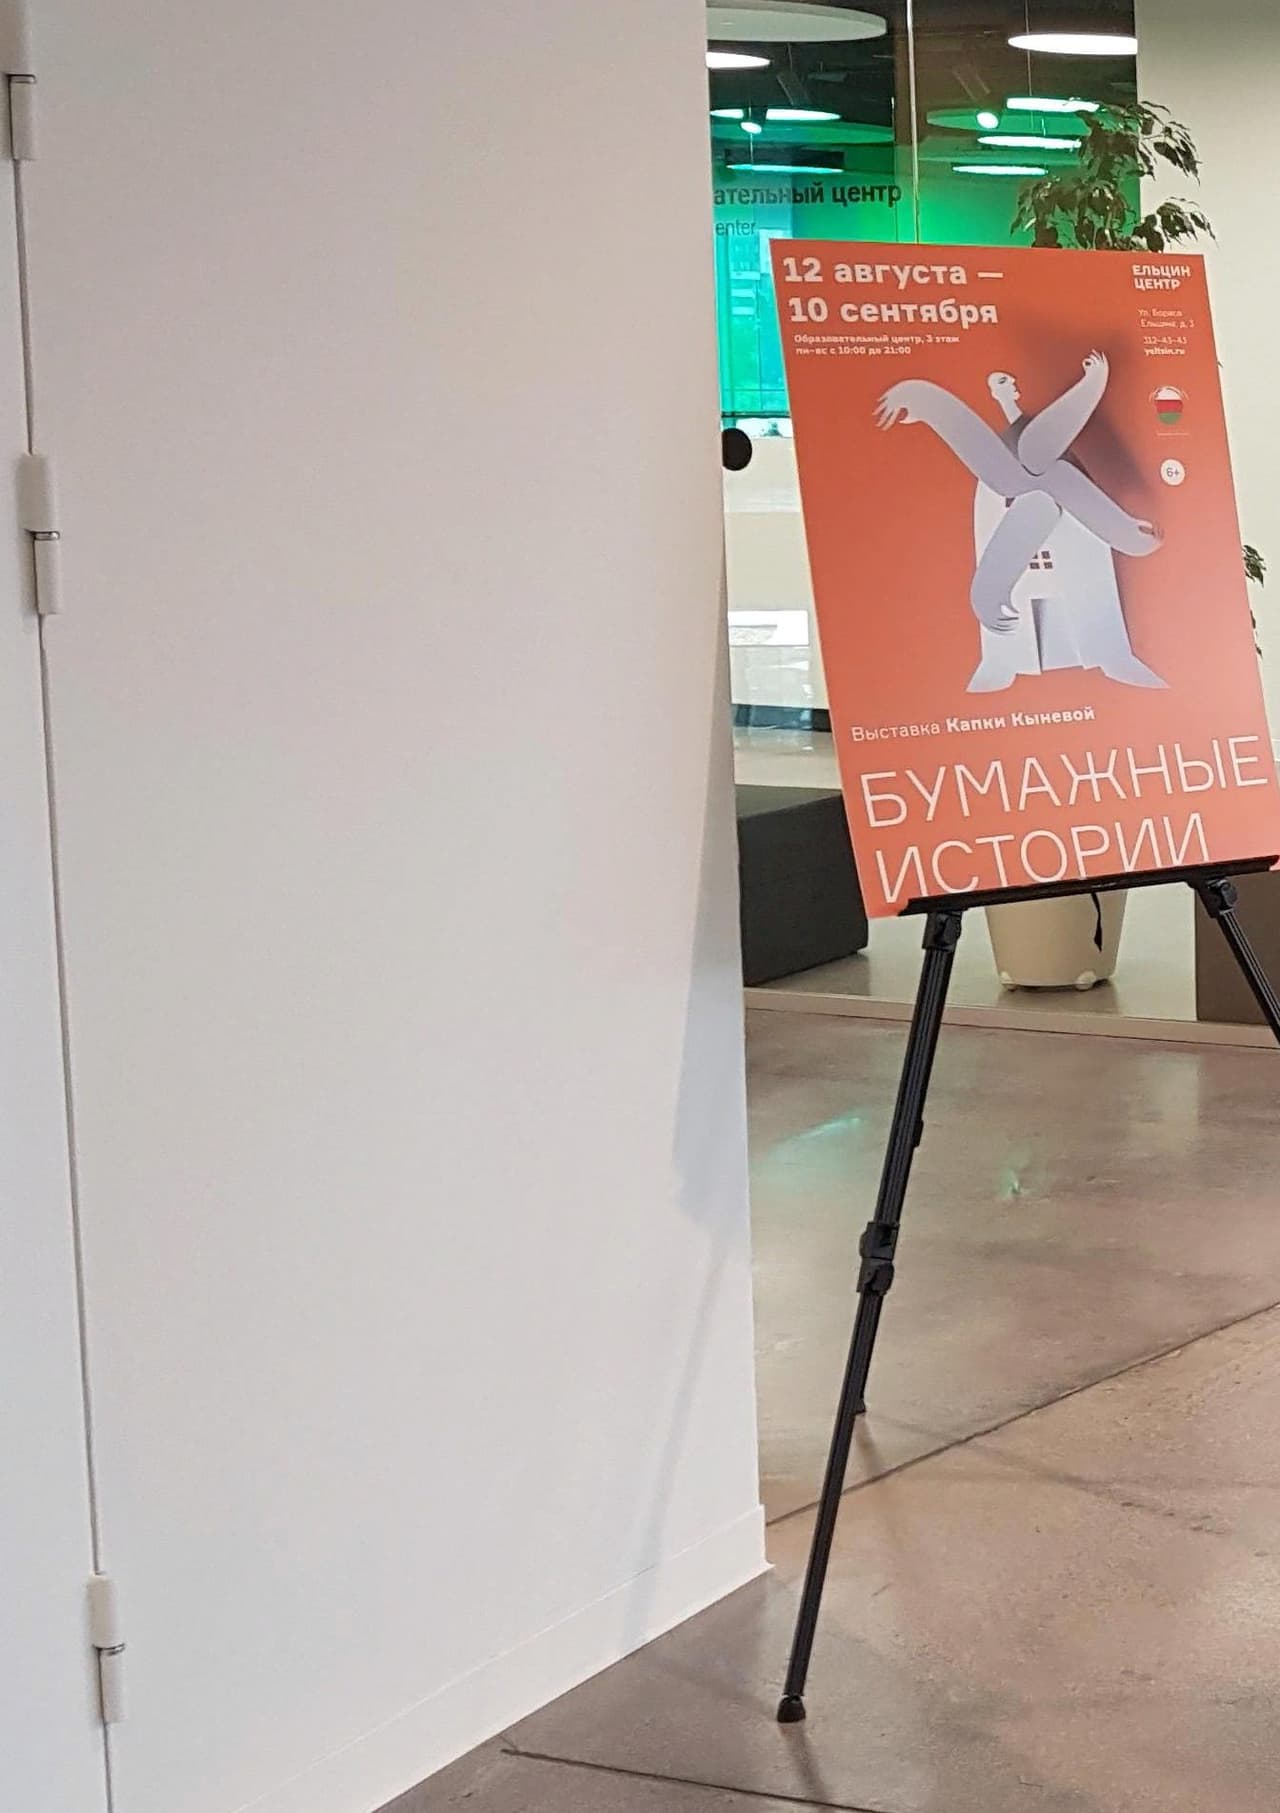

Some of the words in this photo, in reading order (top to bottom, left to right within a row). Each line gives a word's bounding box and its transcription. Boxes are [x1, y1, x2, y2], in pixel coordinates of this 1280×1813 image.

[714, 182, 824, 205] ательный
[831, 185, 901, 207] центр
[783, 257, 823, 282] 12
[834, 263, 967, 290] августа
[1132, 265, 1191, 278] ЕЛЬЦИН
[1134, 278, 1180, 290] ЦЕНТР
[789, 297, 828, 322] 10
[840, 299, 998, 329] сентября
[1167, 467, 1179, 477] 6+
[852, 719, 940, 742] Выставка
[945, 715, 1005, 733] Капки
[1011, 706, 1095, 727] Кыневой
[861, 735, 1268, 828] БУМАЖНЫЕ
[875, 813, 1209, 904] ИСТОРИИ
